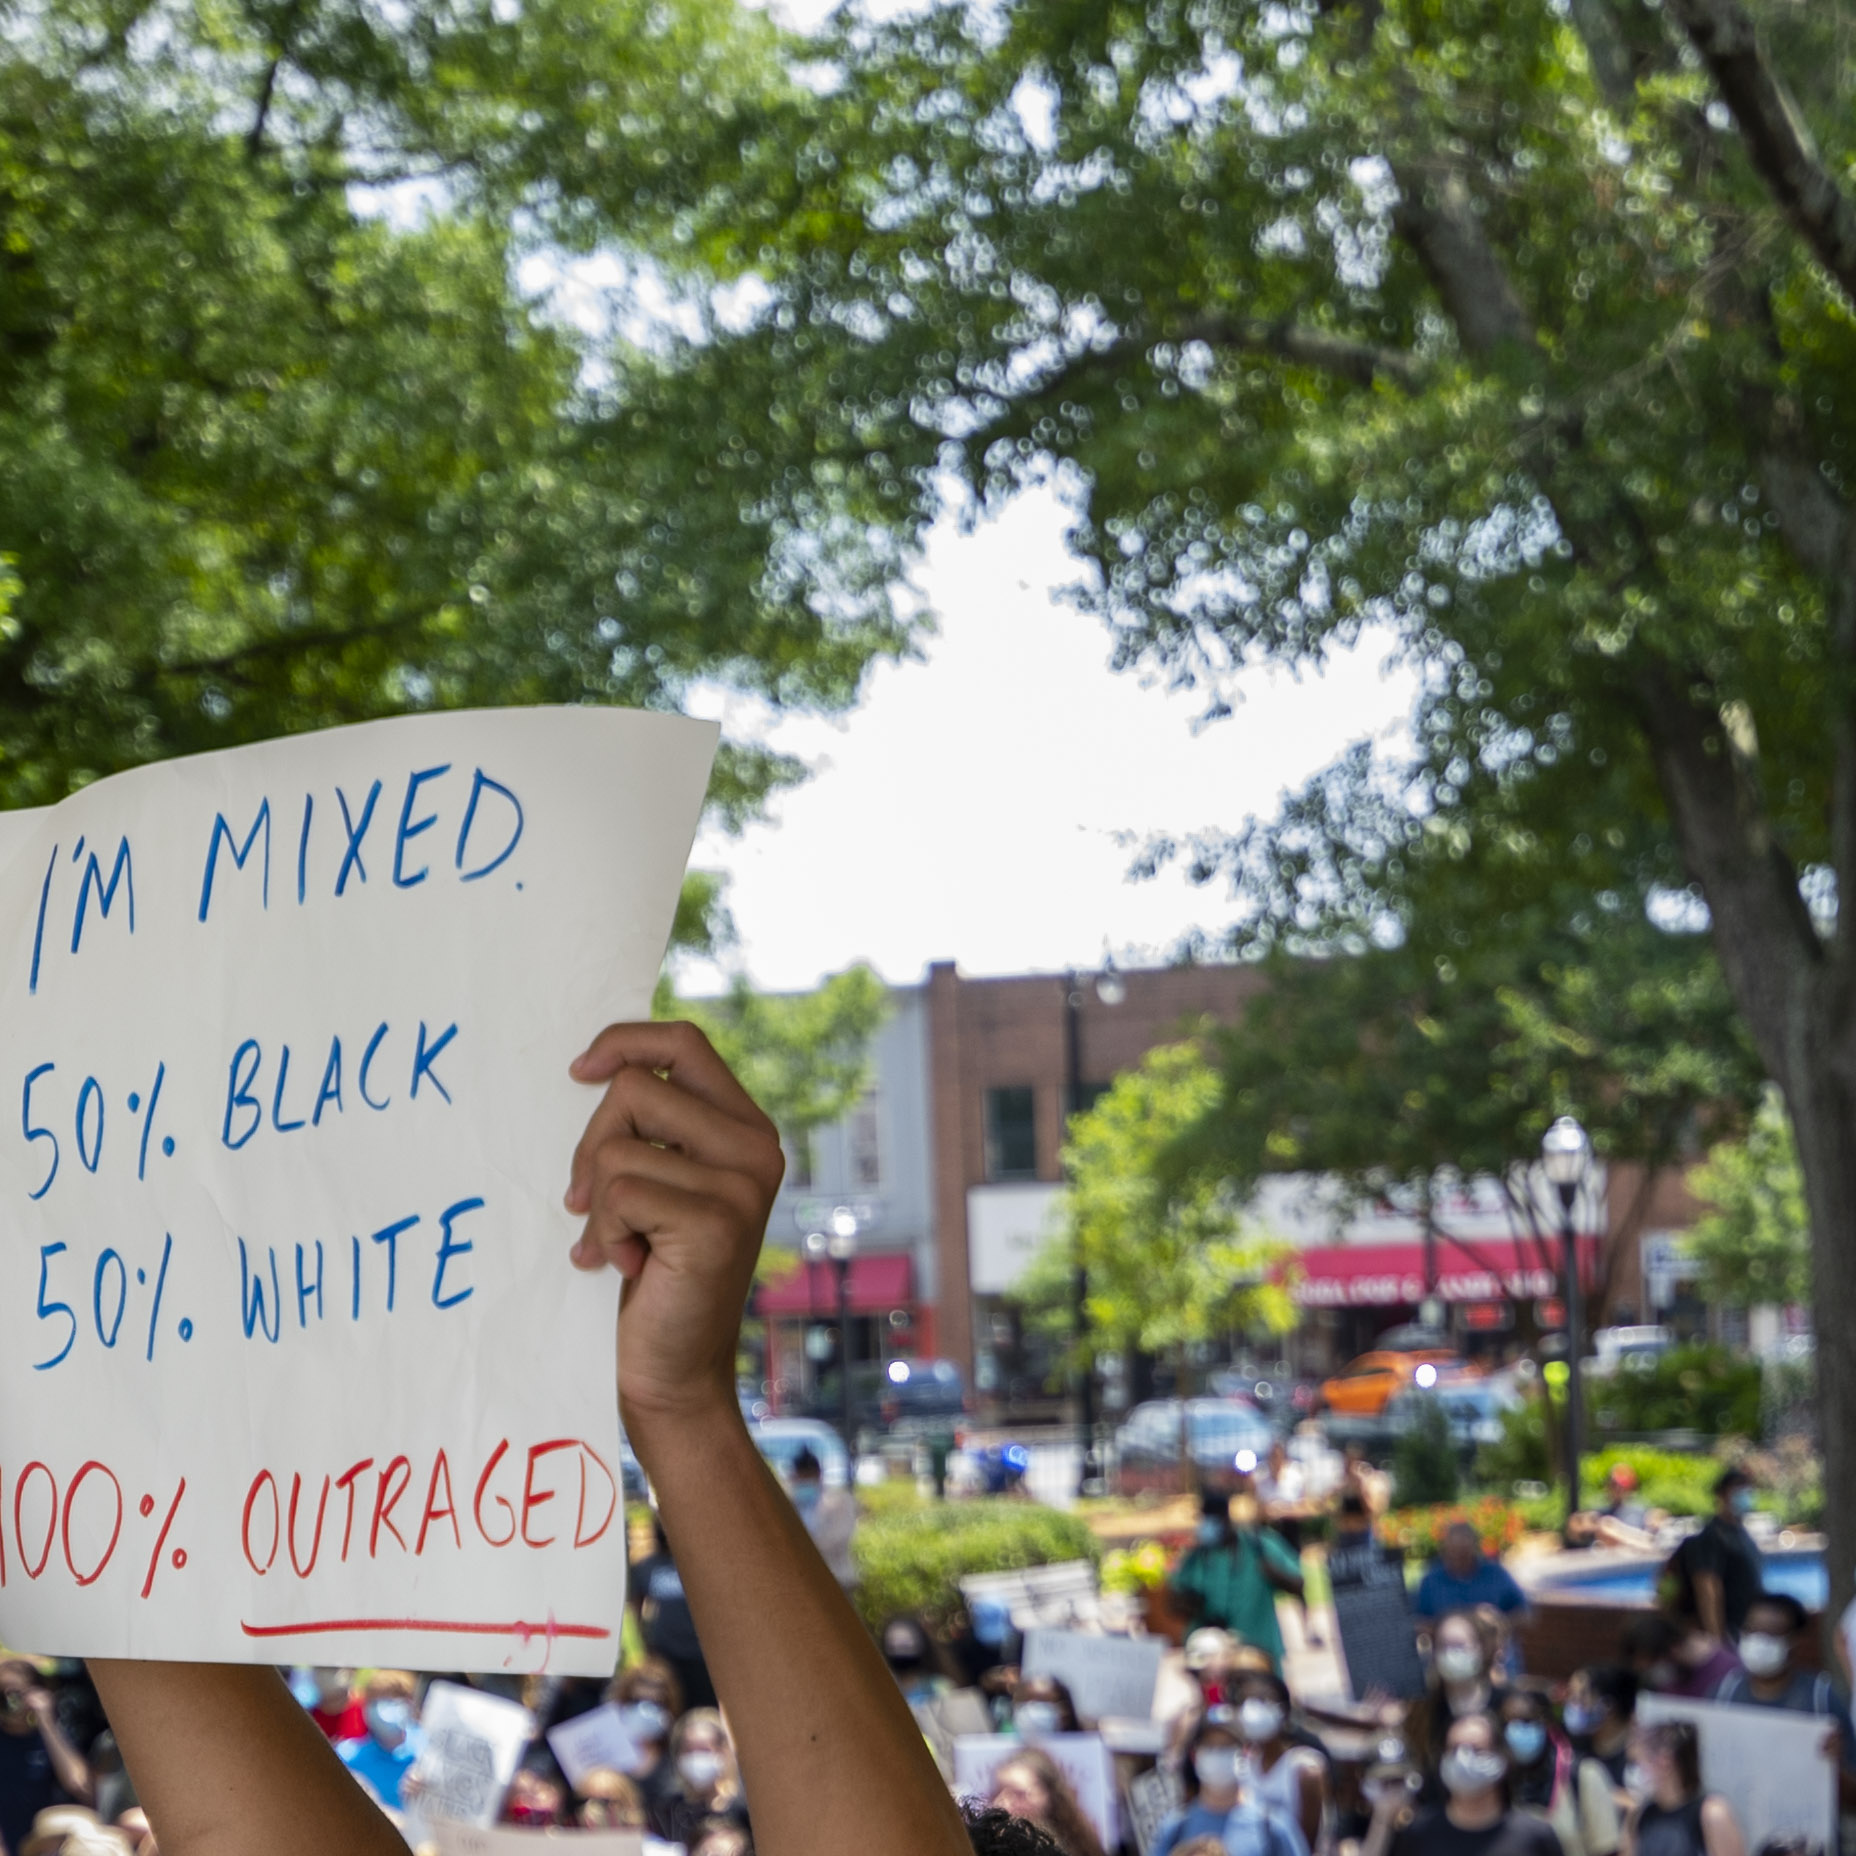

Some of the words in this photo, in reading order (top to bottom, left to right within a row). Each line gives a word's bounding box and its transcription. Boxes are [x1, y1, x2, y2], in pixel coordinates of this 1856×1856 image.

[28, 835, 135, 996] I'M
[21, 1061, 177, 1201] 50%
[221, 1021, 460, 1151] BLACK
[33, 1234, 195, 1372] 50%
[238, 1195, 486, 1344] WHITE
[241, 1437, 617, 1580] OUTRAGED
